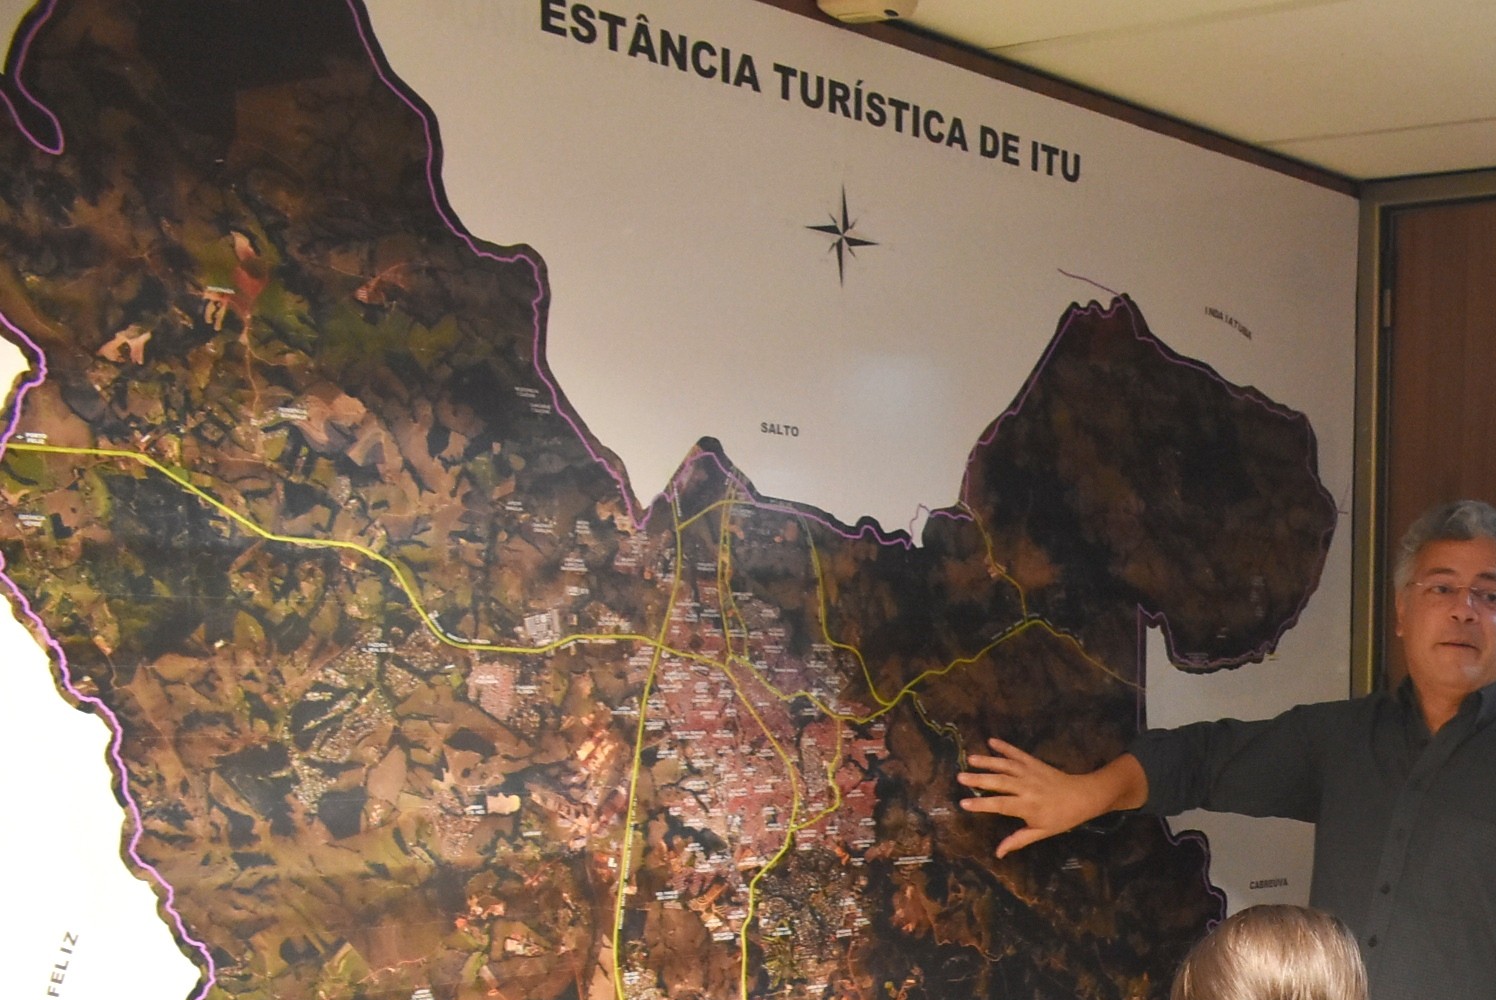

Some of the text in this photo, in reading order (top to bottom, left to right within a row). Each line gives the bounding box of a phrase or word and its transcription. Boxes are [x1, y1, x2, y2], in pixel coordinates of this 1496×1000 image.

[540, 0, 761, 94] ESTÂNCIA
[773, 62, 969, 153] TURÍSTICA
[979, 124, 1021, 167] DE
[1031, 140, 1082, 184] ITU
[760, 421, 800, 438] SALTO
[47, 931, 79, 998] FELIZ
